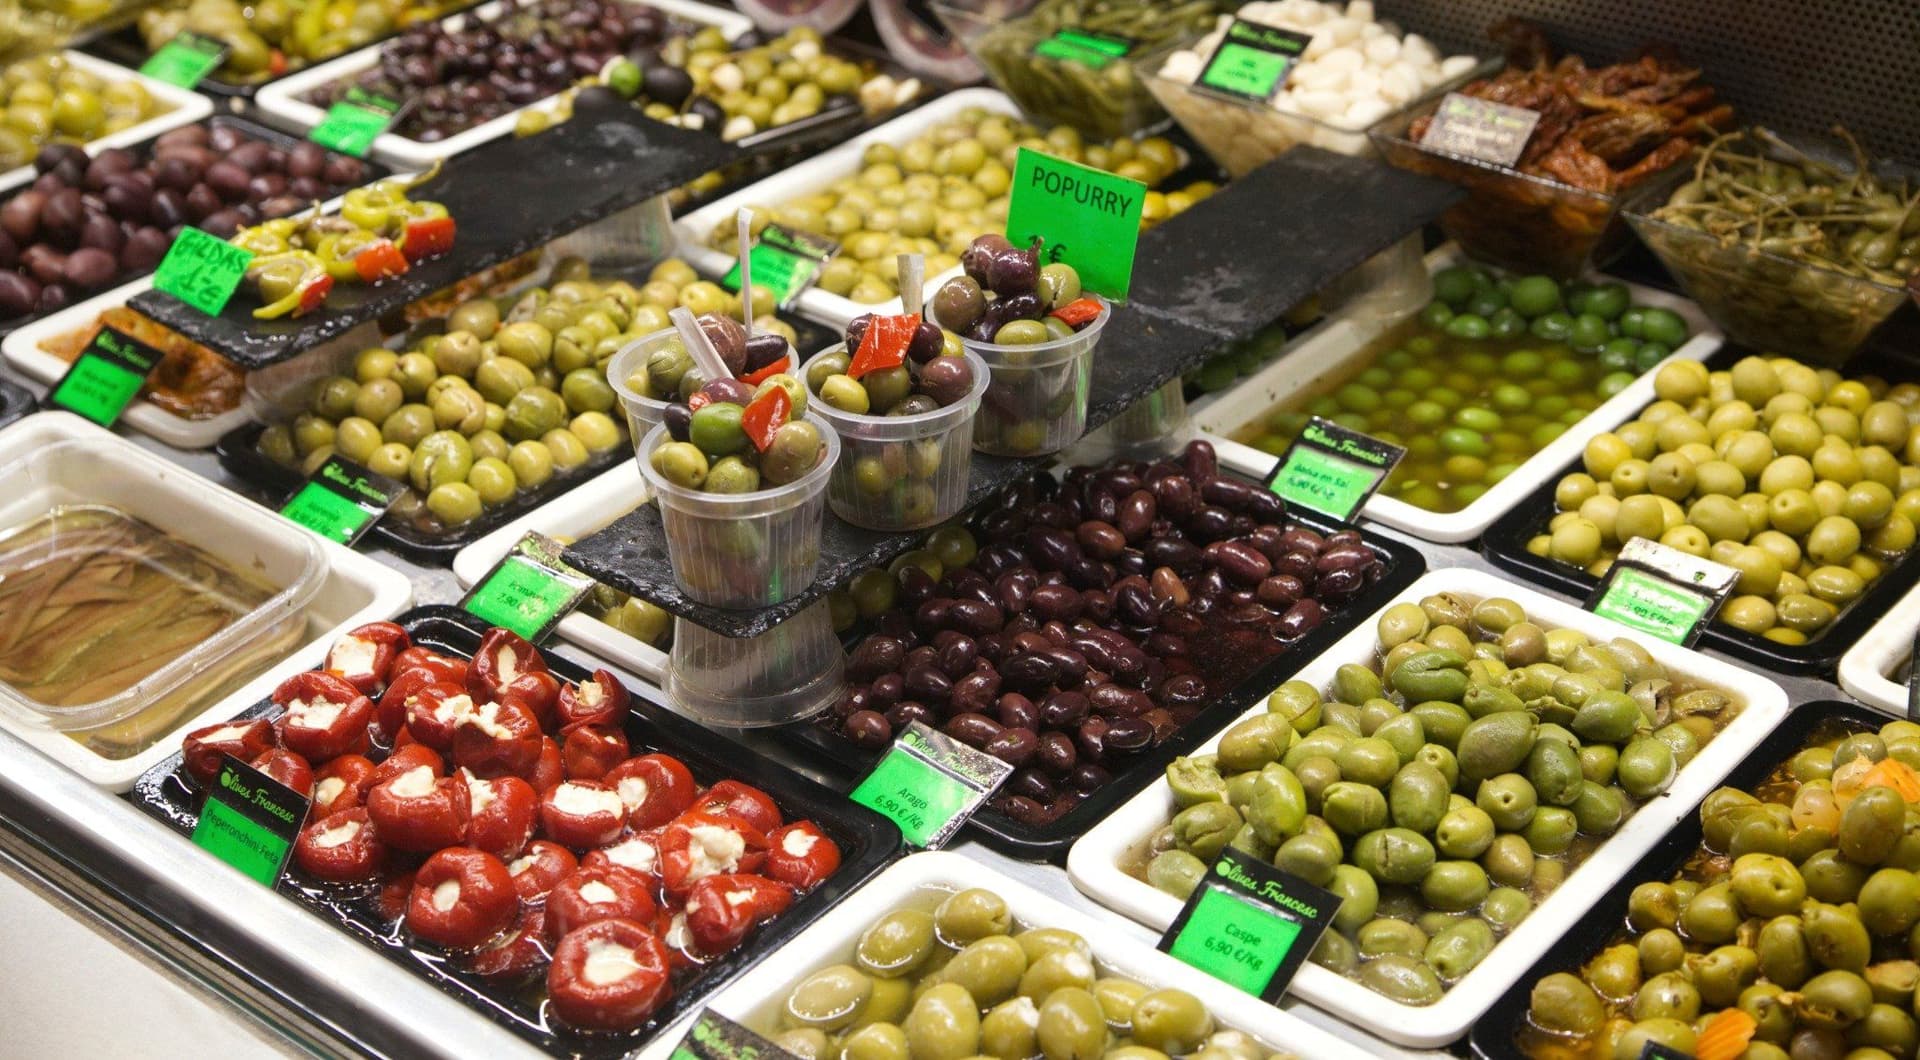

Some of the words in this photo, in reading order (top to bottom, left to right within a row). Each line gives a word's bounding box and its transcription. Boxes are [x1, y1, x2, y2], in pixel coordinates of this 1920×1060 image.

[1032, 166, 1133, 218] POPURRY
[875, 794, 899, 813] 6,90
[1216, 857, 1258, 890] Olives
[1257, 880, 1319, 919] Francesc
[1204, 936, 1233, 957] 6,90
[1225, 922, 1262, 947] Caspe
